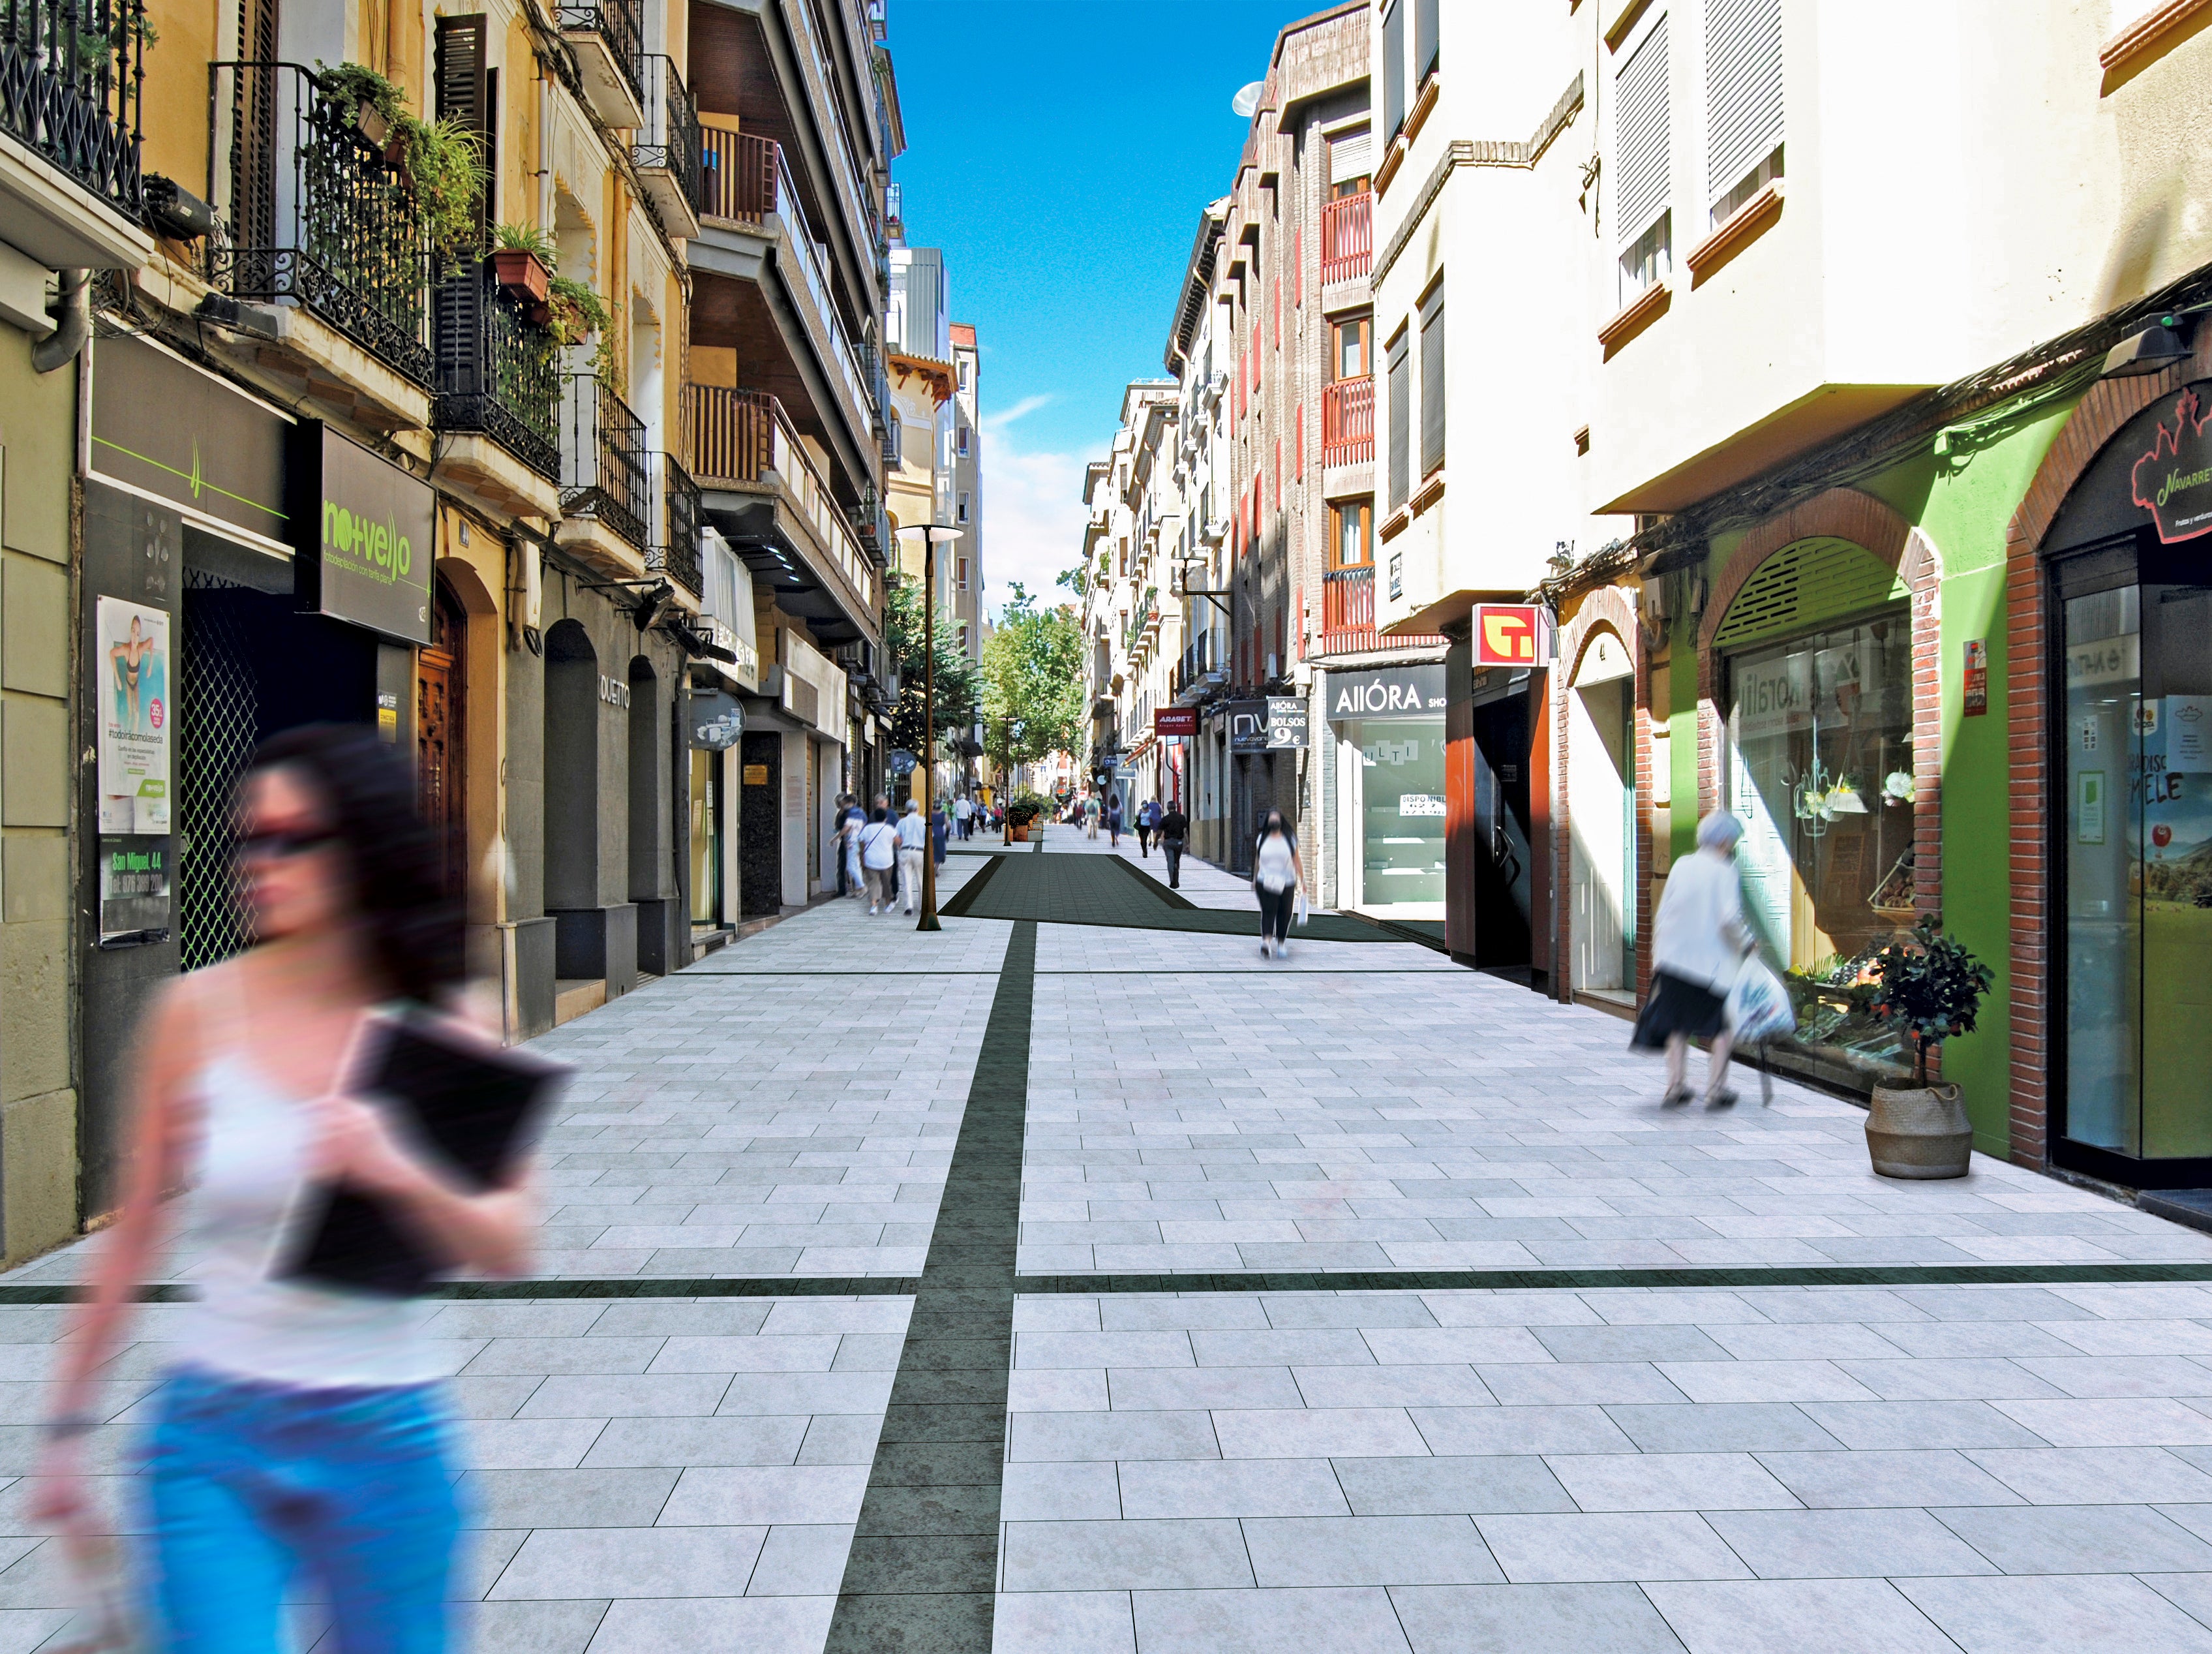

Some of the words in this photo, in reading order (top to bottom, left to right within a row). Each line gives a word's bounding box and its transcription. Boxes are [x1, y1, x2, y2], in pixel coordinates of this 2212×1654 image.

[2157, 467, 2212, 506] NAVARRE
[600, 674, 630, 709] DUETTO
[1270, 717, 1306, 727] BOLSOS
[112, 852, 126, 871] San
[127, 851, 151, 873] Miguel,
[151, 851, 161, 870] 44
[123, 874, 136, 893] 976
[150, 874, 163, 892] 200
